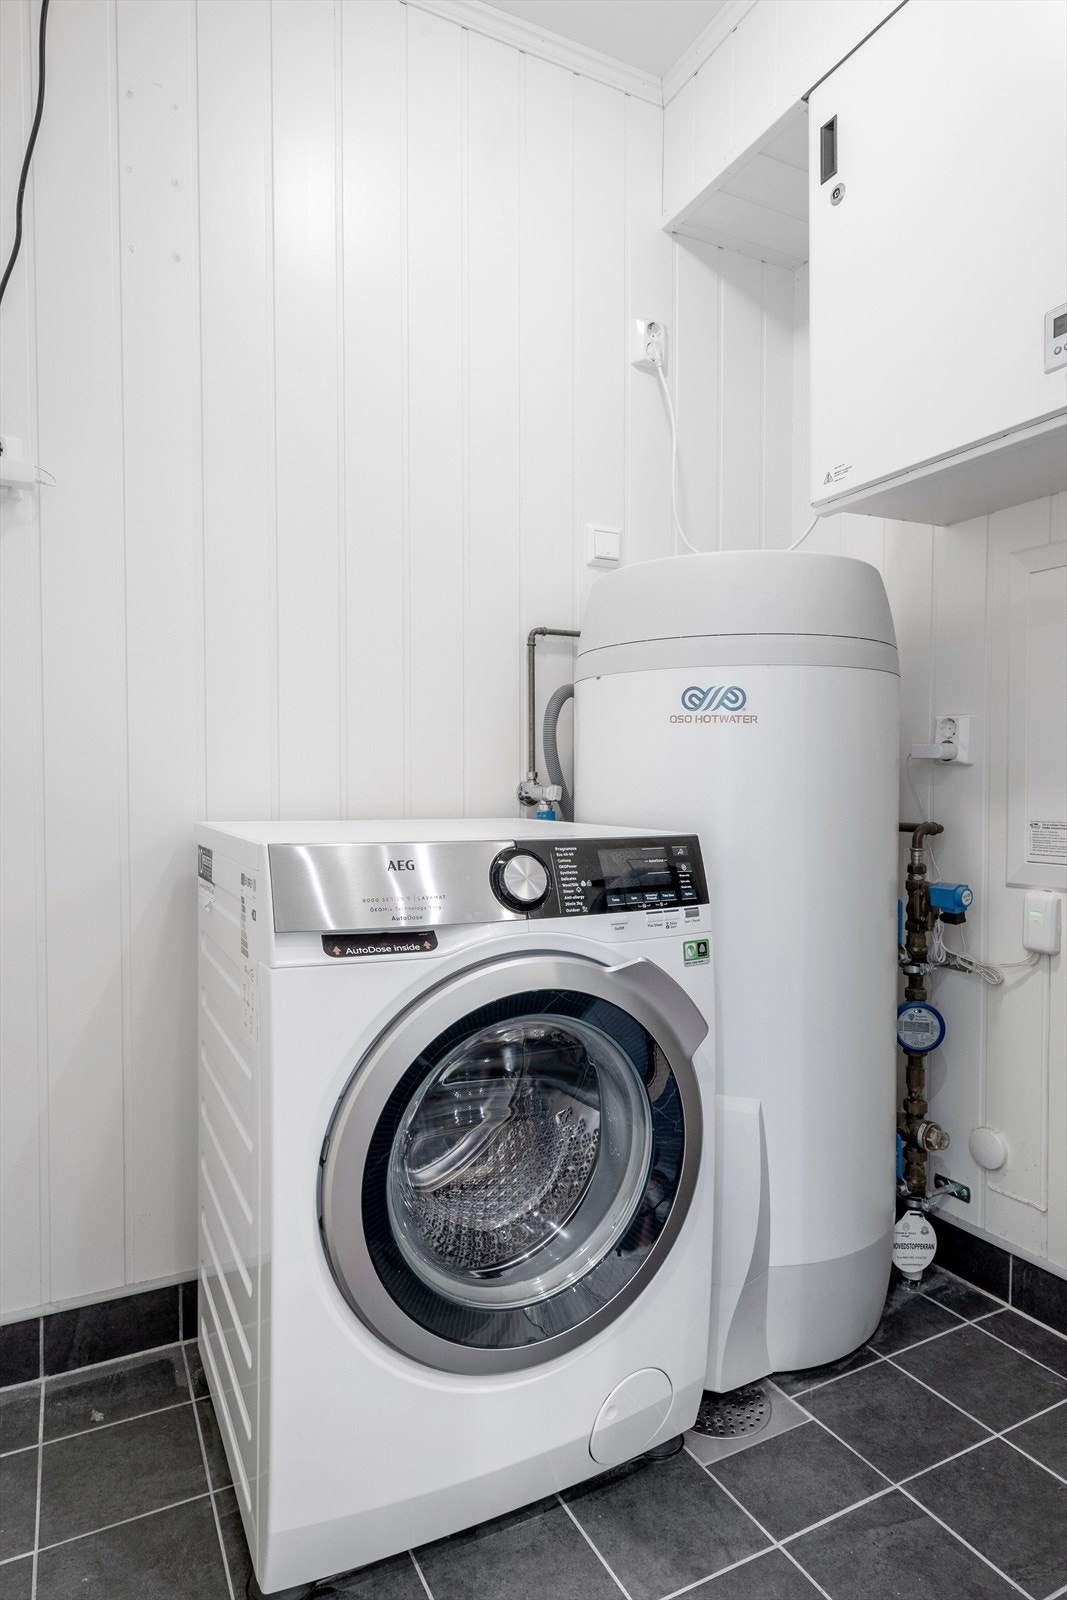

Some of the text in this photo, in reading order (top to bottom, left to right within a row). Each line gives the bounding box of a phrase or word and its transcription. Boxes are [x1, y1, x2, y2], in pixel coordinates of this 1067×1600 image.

[669, 714, 758, 724] OSO HOTWATER
[387, 860, 415, 871] AEG
[345, 943, 421, 955] AutoDose inside
